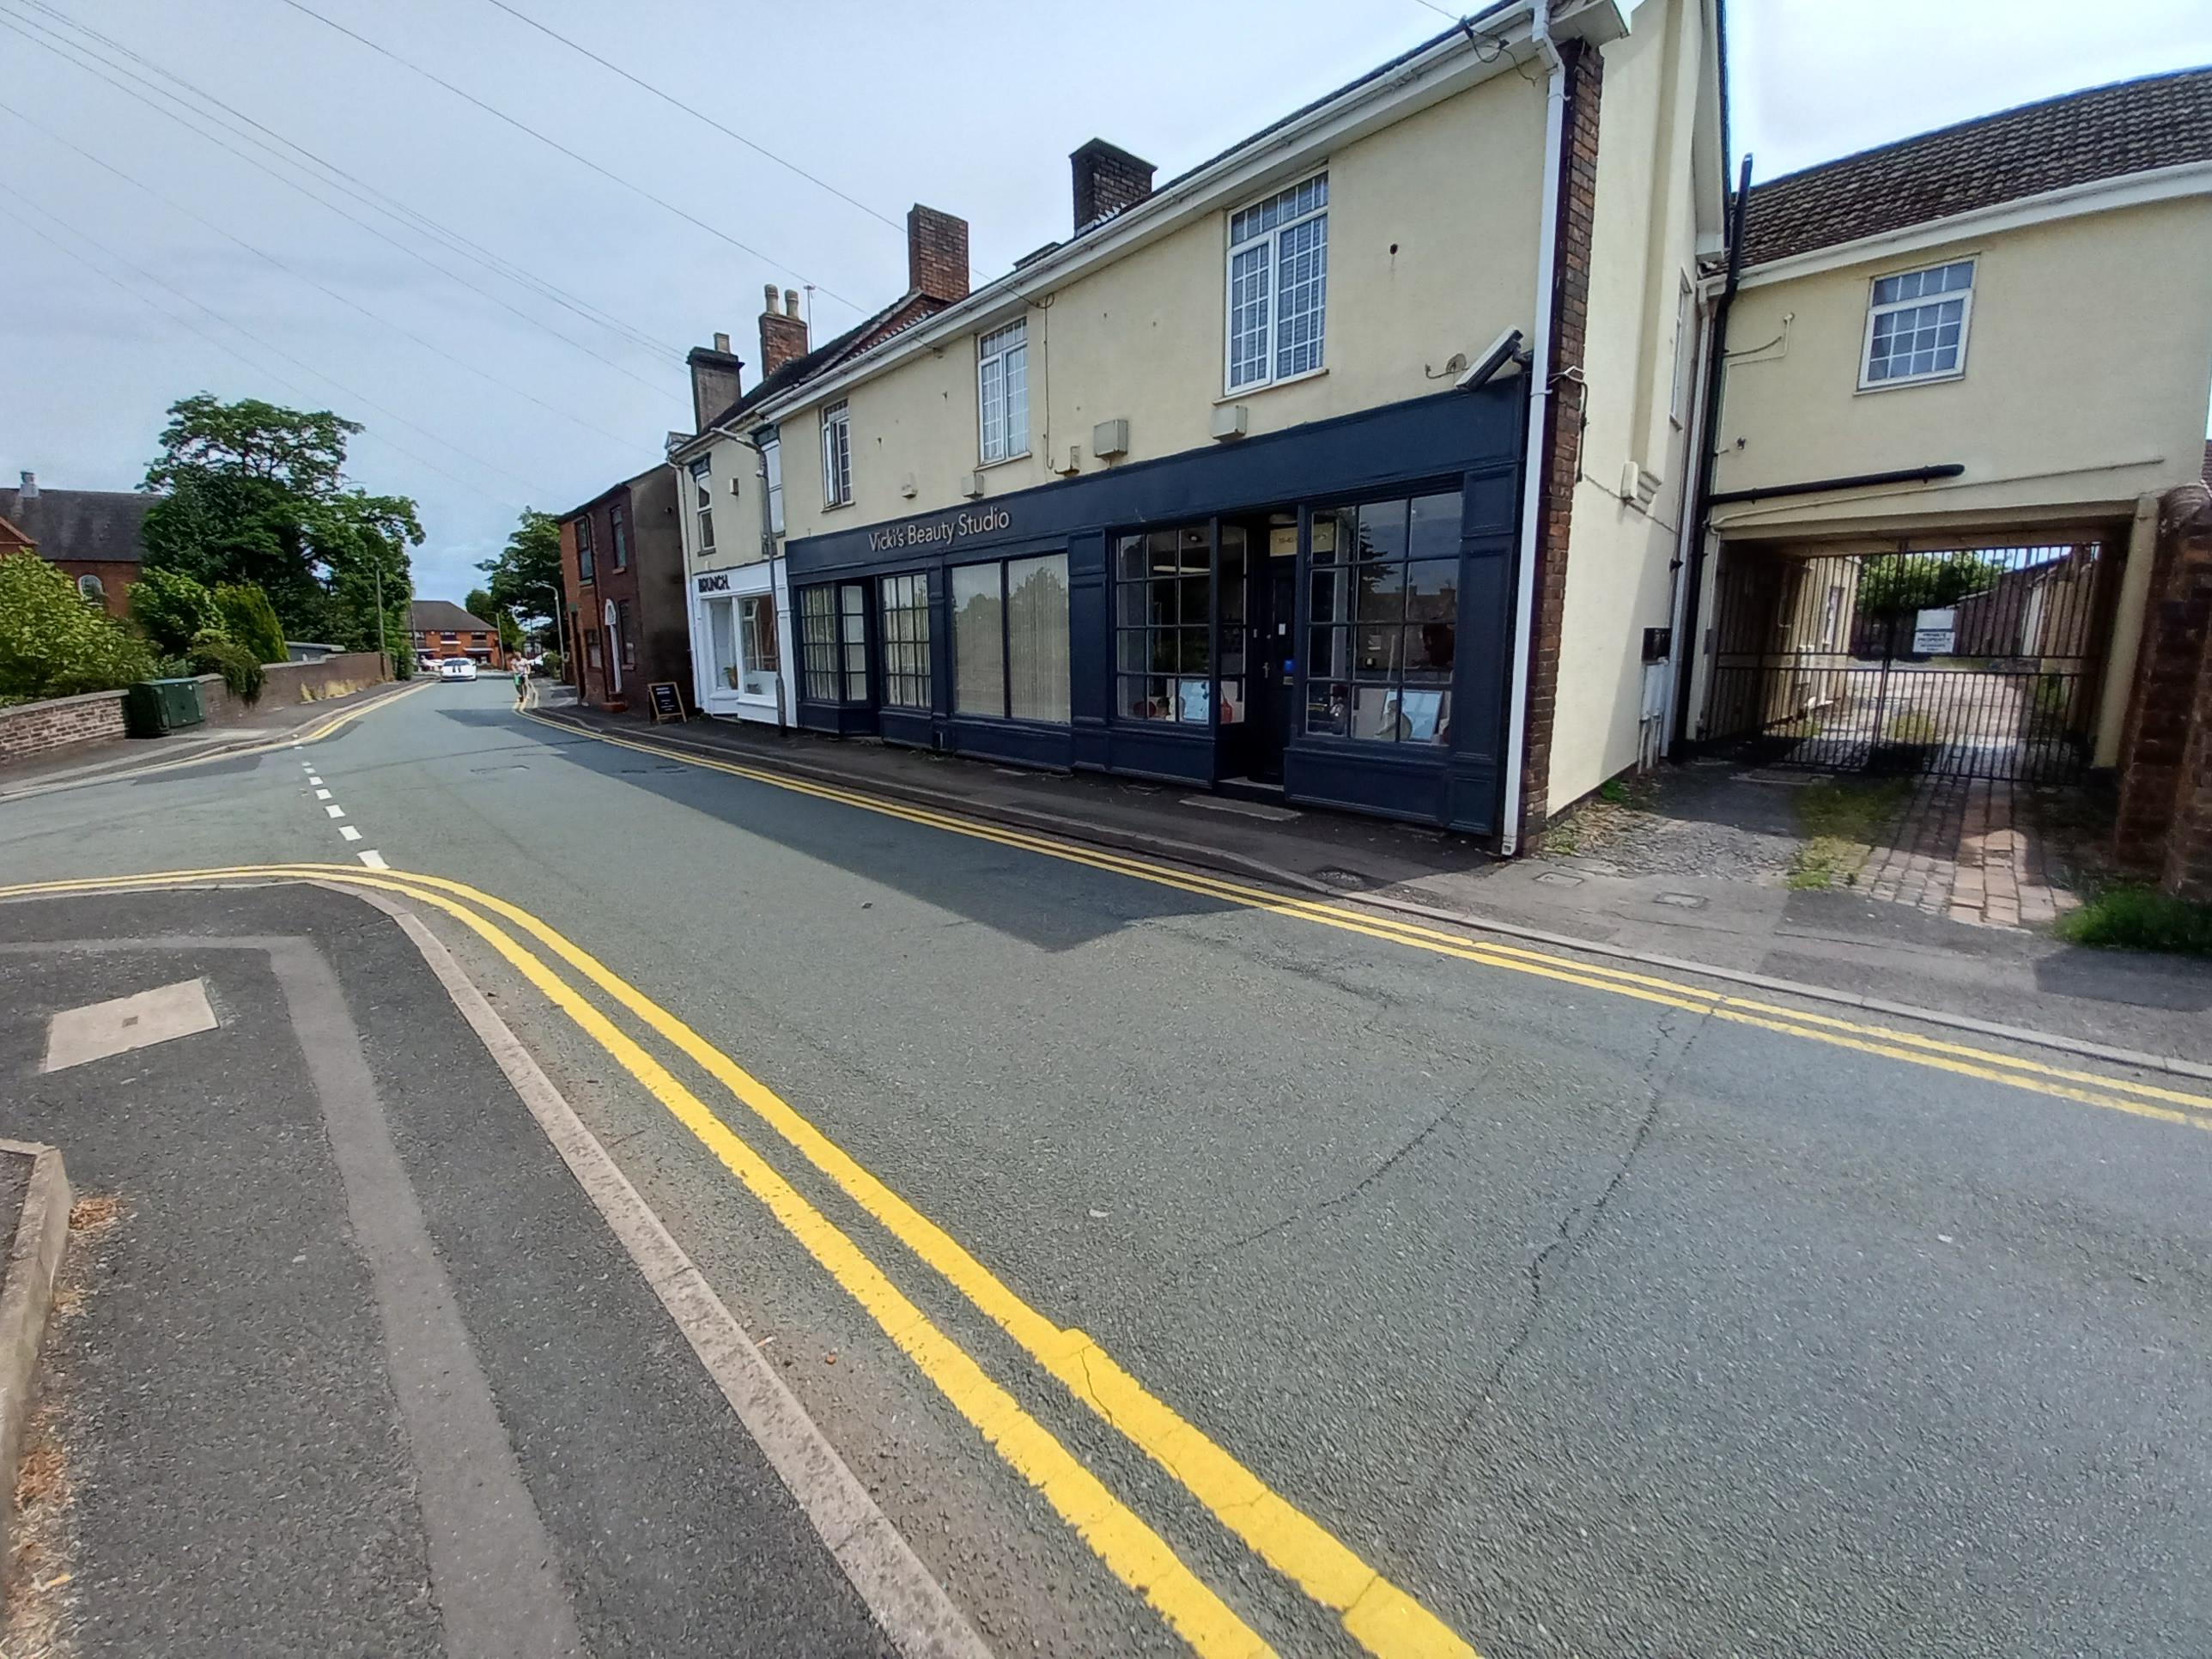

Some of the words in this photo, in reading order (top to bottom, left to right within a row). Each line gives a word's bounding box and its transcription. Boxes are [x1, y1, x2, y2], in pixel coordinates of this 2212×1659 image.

[868, 526, 904, 552] Vicki's
[908, 521, 954, 545] Beauty
[957, 506, 1010, 537] Studio
